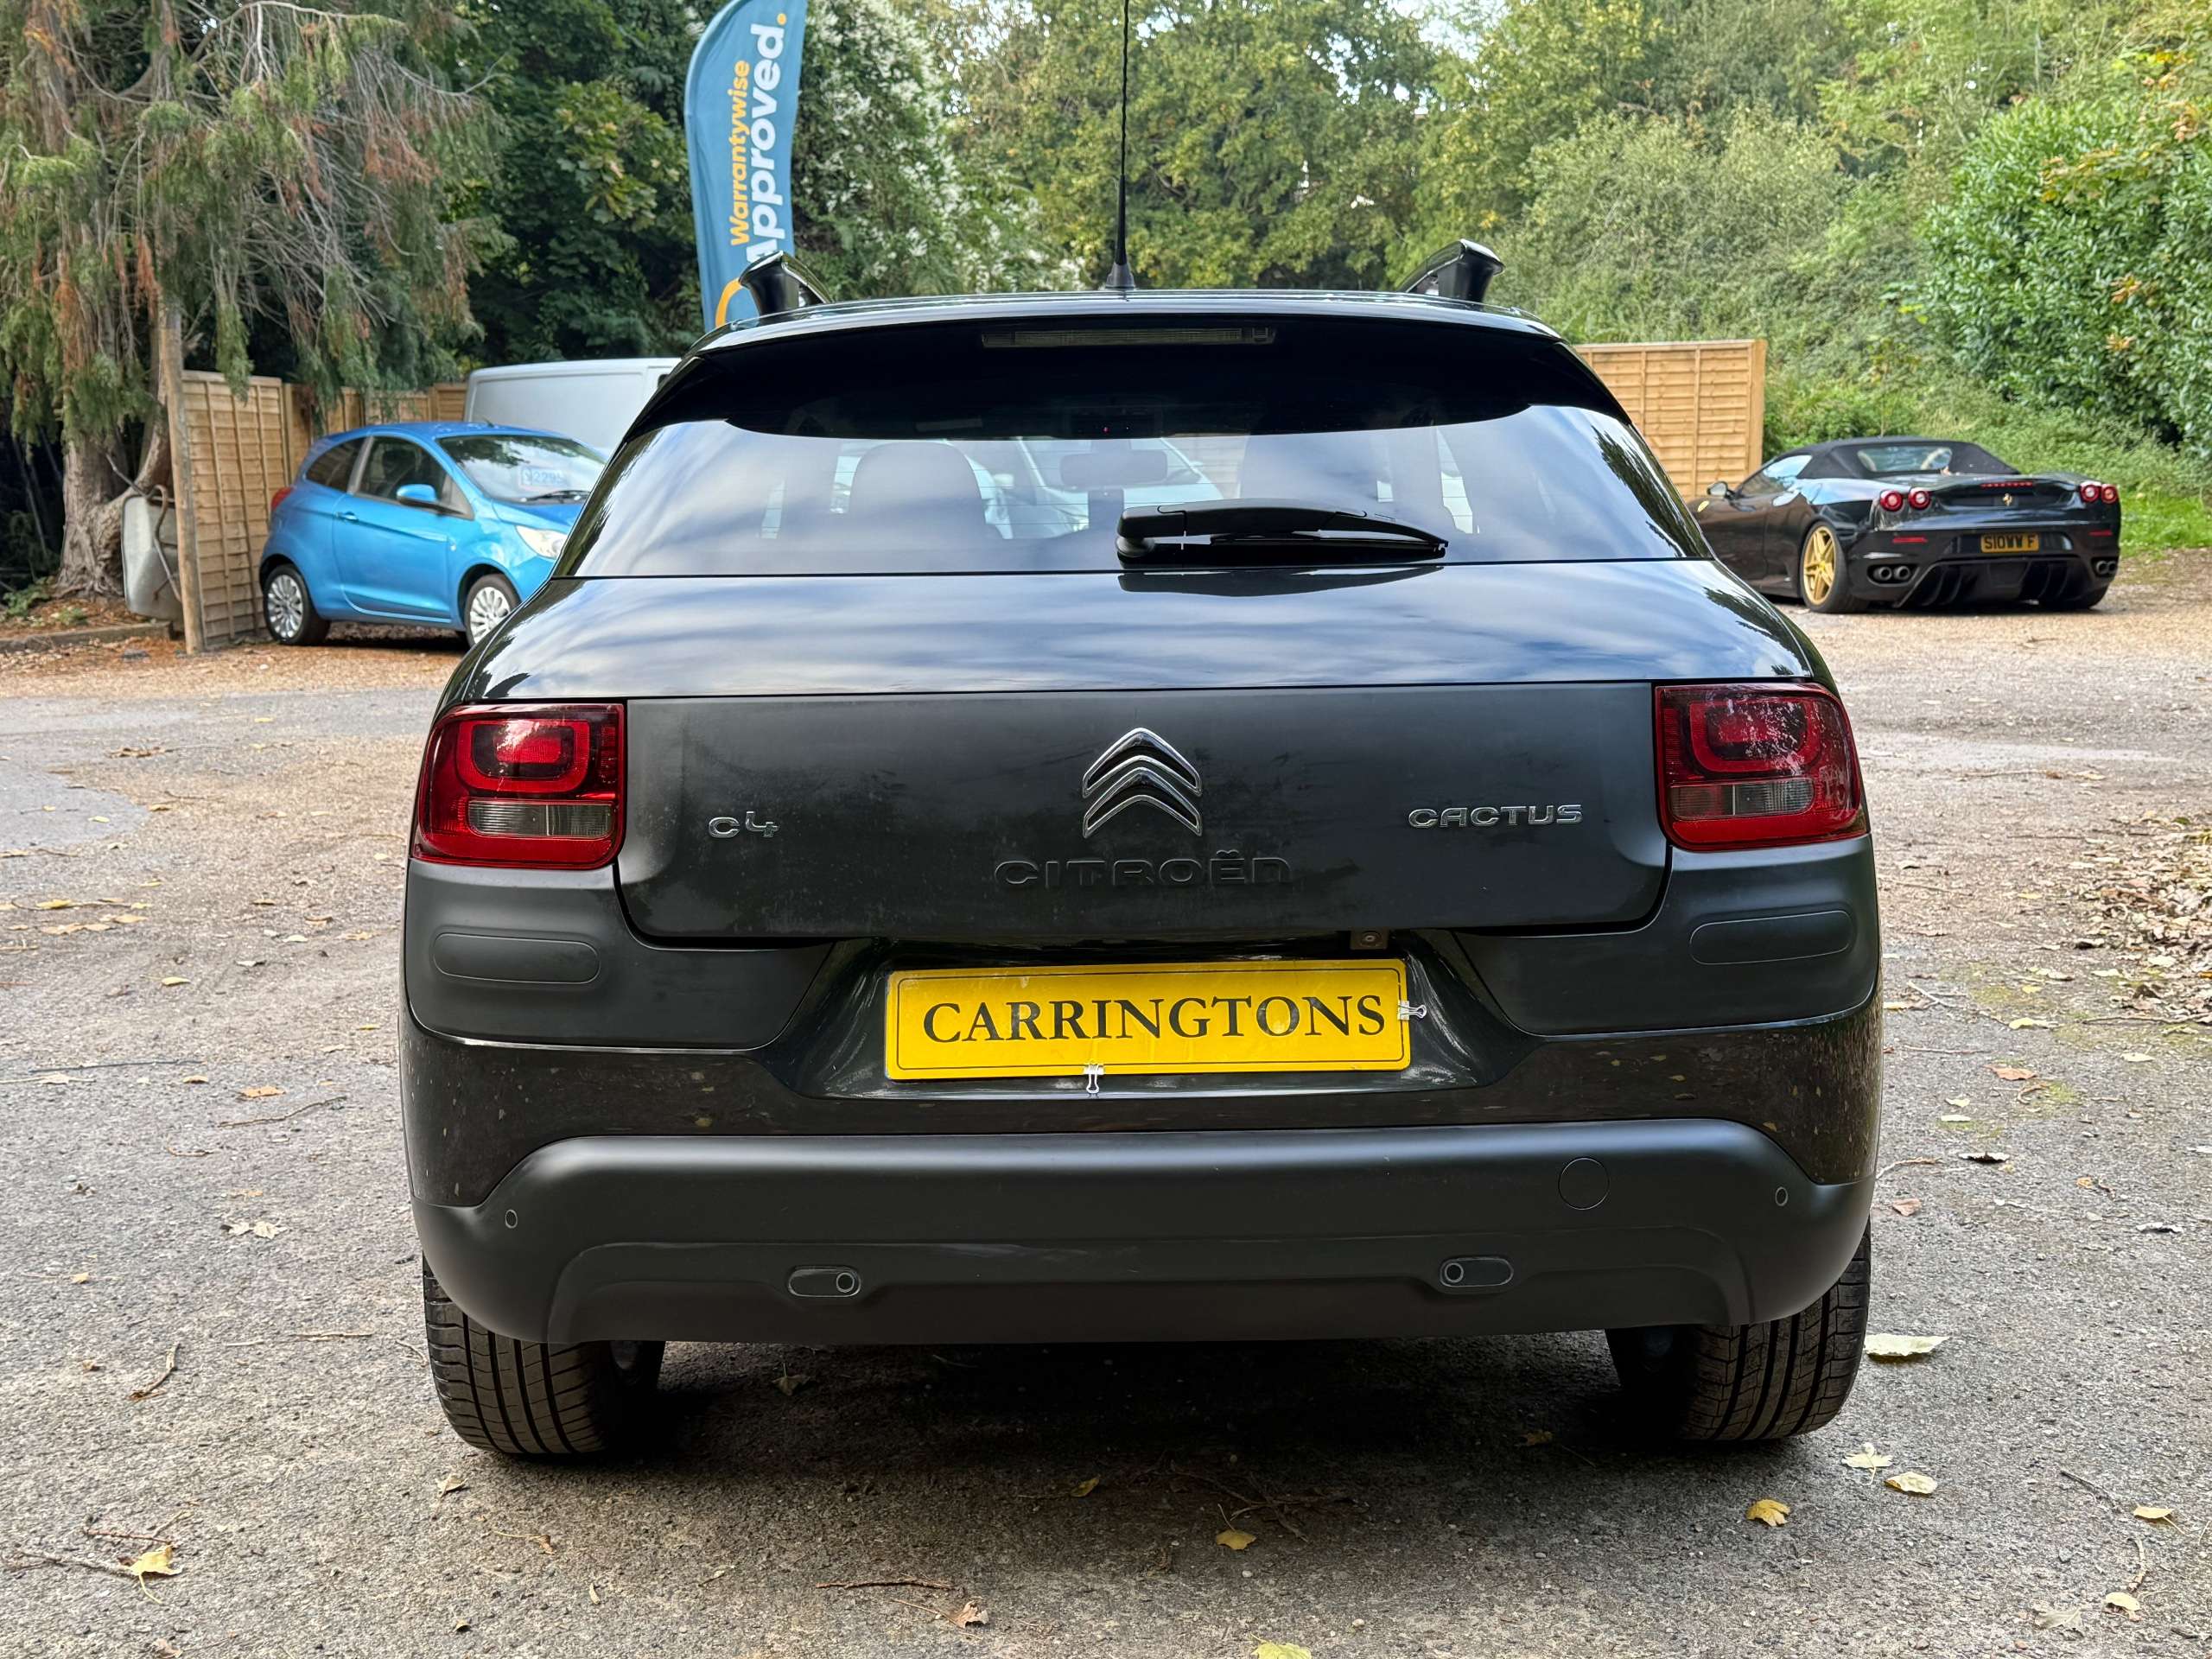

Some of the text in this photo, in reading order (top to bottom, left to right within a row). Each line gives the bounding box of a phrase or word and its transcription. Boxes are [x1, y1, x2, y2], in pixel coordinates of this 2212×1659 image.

[728, 60, 750, 245] Warrantywise
[709, 810, 779, 838] C4
[1408, 804, 1584, 828] CACTUS
[922, 995, 1385, 1044] CARRINGTONS
